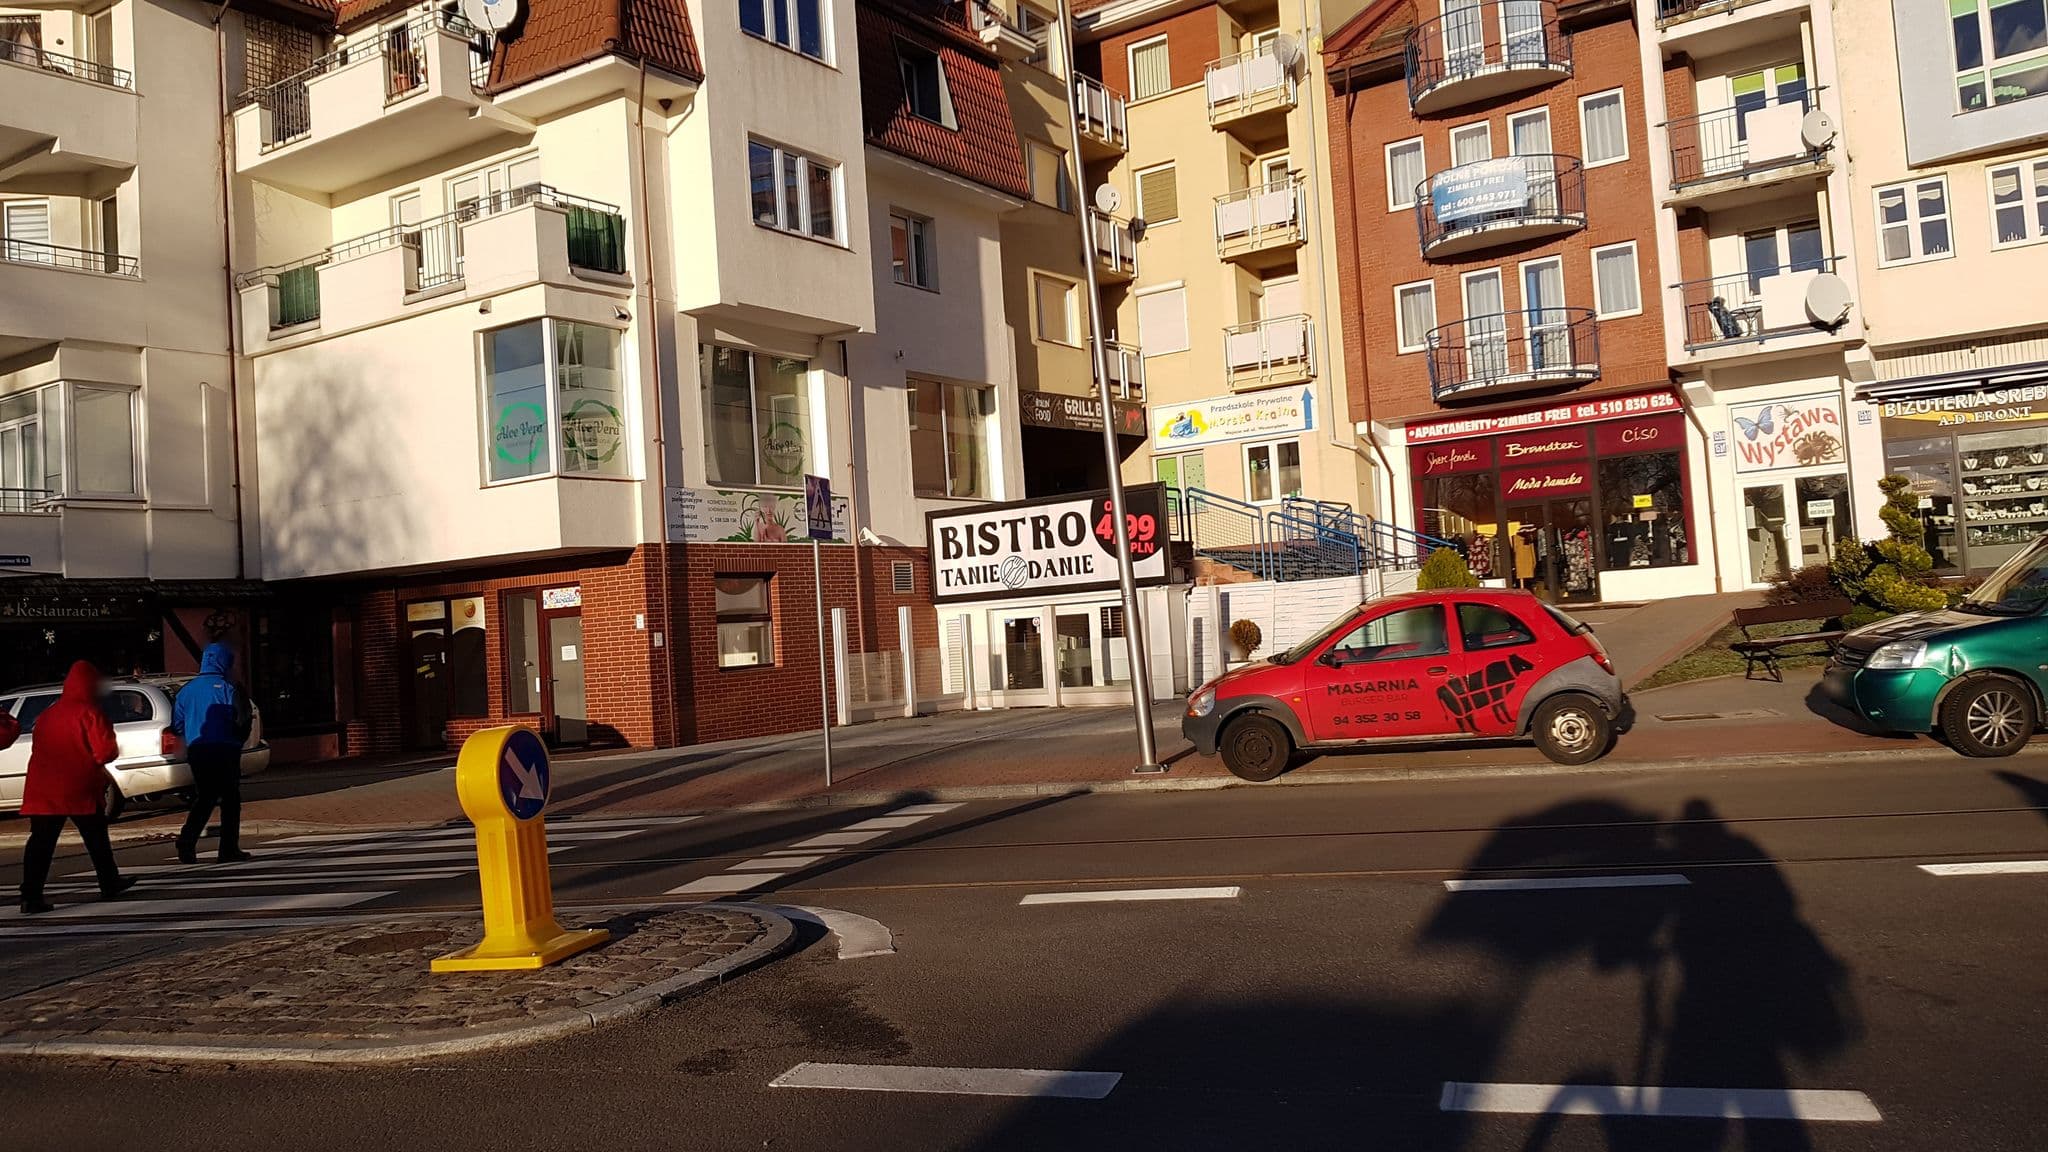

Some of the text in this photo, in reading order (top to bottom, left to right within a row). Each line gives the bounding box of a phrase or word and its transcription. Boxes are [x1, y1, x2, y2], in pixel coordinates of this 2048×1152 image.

[1447, 176, 1504, 194] ZIMMER FREI
[1457, 197, 1474, 207] 600
[1497, 190, 1516, 199] 971
[1995, 385, 2048, 404] SREB
[1064, 398, 1094, 417] GRILL
[1210, 395, 1293, 413] Przedszkole Prywatne
[1035, 408, 1052, 422] FOOD
[1256, 407, 1297, 421] Kraina
[1415, 394, 1674, 438] APARTAMENTY ZIMMER FREI tel. 510 830 626
[1974, 406, 2032, 421] FRONT
[497, 424, 519, 441] Aloe
[594, 420, 619, 436] Vera
[1622, 427, 1658, 443] Ciso
[1737, 407, 1839, 467] Wystawa
[1505, 442, 1583, 457] Brandtex
[1508, 473, 1584, 494] Moda damska
[940, 511, 1086, 560] BISTRO
[1130, 542, 1154, 553] PLN
[941, 554, 1094, 587] TANIE DANIE
[16, 602, 99, 618] Restauracja
[1328, 678, 1419, 696] MASARNIA
[1342, 693, 1408, 706] BURGER BAR
[1333, 711, 1421, 726] 94 352 30 58
